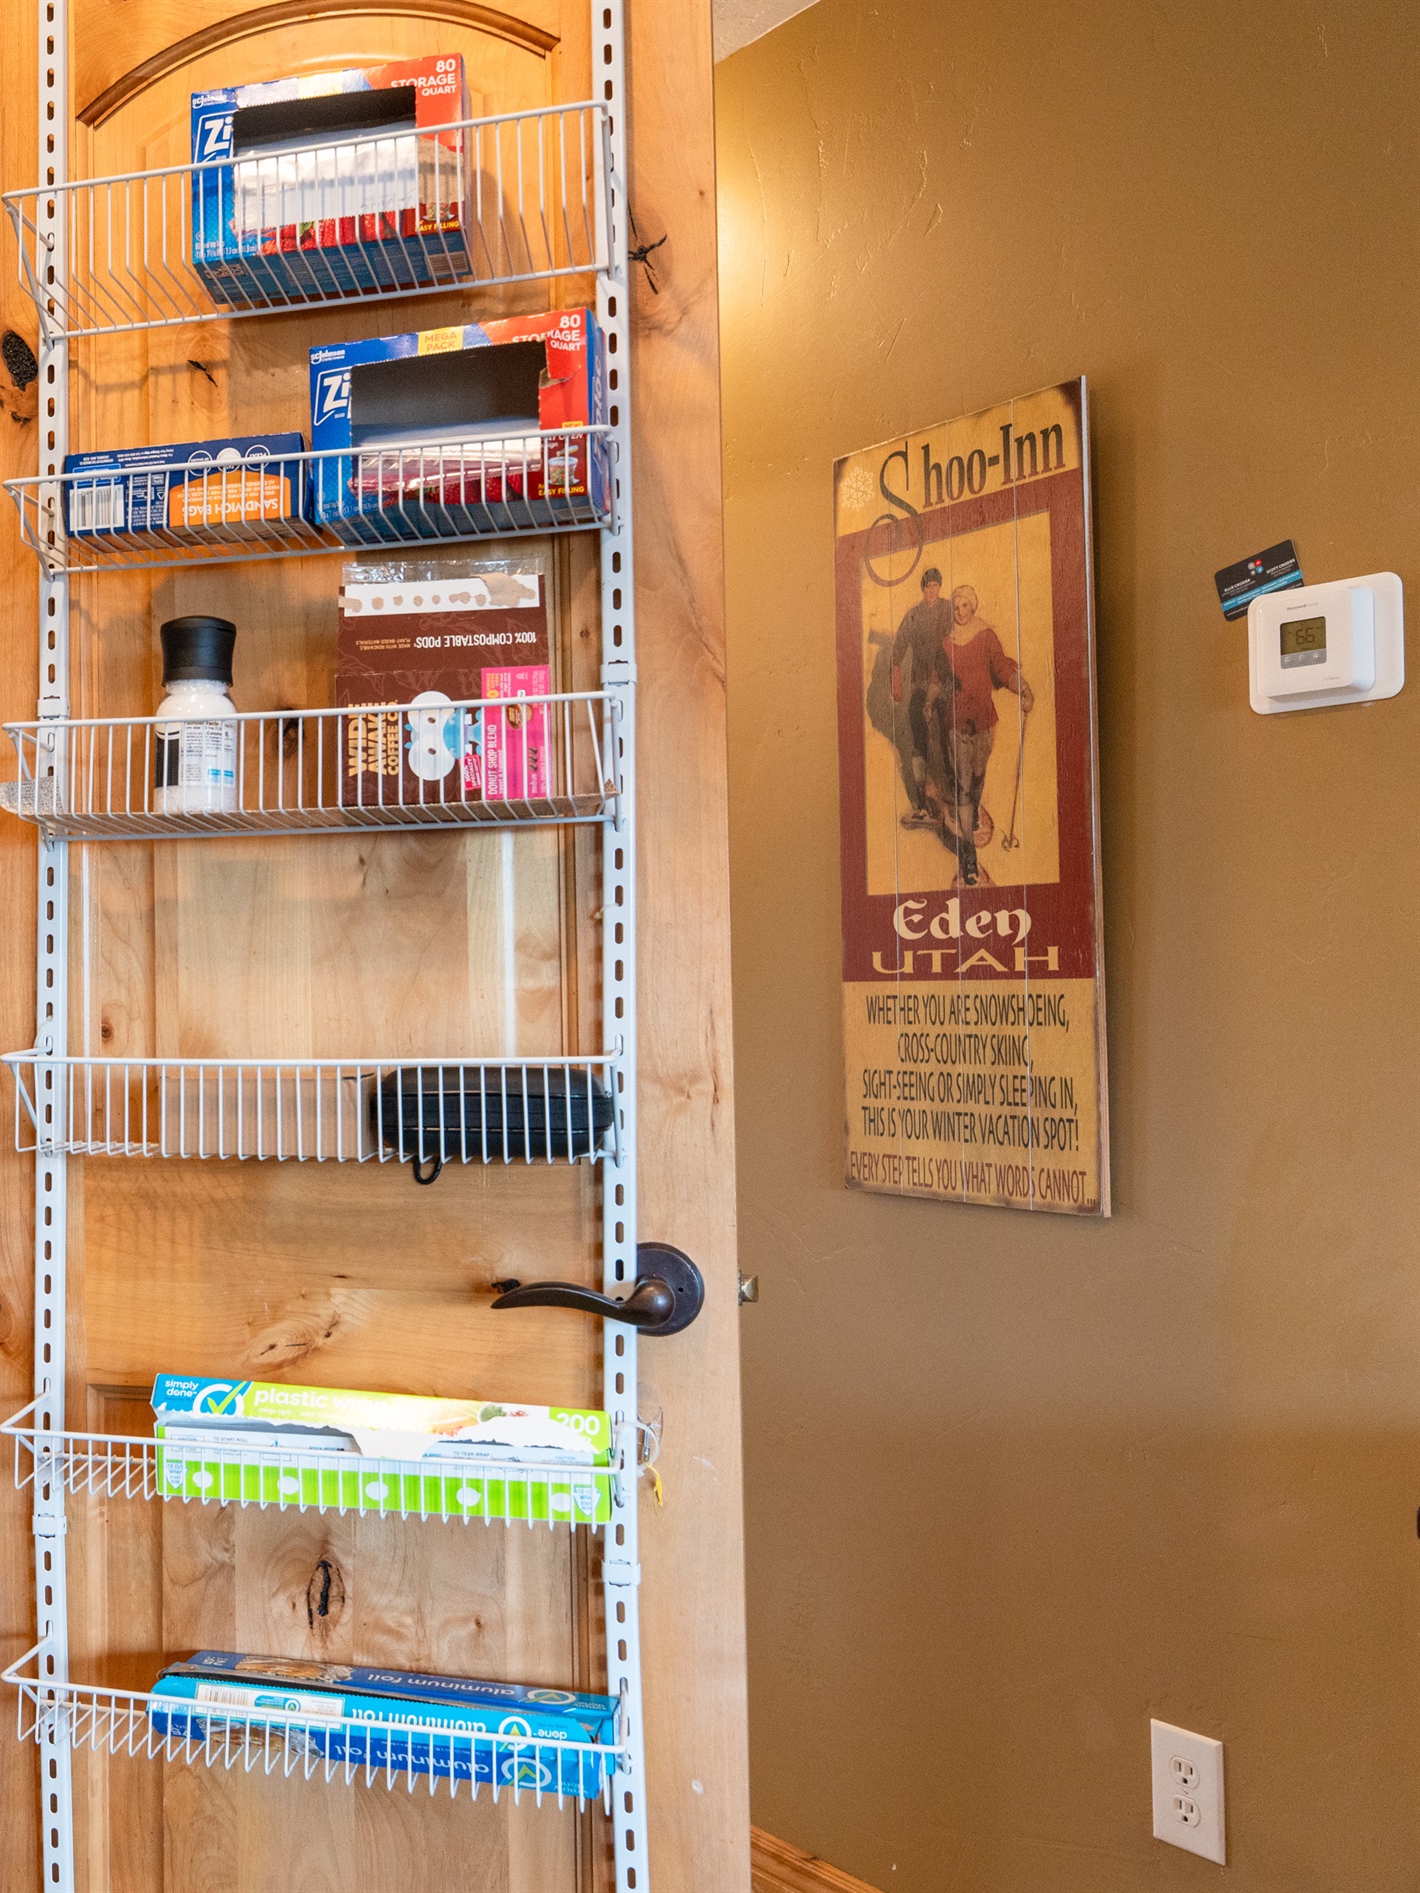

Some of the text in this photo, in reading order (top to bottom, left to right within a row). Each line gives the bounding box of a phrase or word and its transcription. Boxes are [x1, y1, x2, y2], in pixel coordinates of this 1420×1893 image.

[436, 58, 456, 72] 80
[390, 74, 456, 88] STORAGE
[422, 85, 456, 96] QUART
[415, 223, 432, 232] ASY
[560, 314, 581, 328] 80
[424, 331, 458, 342] MEGA
[550, 340, 580, 351] QUART
[426, 341, 456, 351] PACK
[182, 504, 212, 516] BAGS
[865, 423, 1066, 588] Shoo-Inn
[444, 632, 512, 648] COMPOSTABLE
[514, 632, 537, 644] 100%
[1296, 627, 1316, 645] 66
[386, 725, 398, 776] COFFEE
[487, 724, 498, 795] DONUT SHOP BLEND
[893, 898, 1032, 946] Eden
[872, 946, 1060, 974] UTAH
[866, 994, 1070, 1033] WHETHER YOU ARE SNOWSHOEING,
[898, 1033, 1034, 1072] CROSS-COUNTRY SKIING,
[862, 1069, 1078, 1116] SIGHT-SEEING OR SIMPLY SLEEPING IN,
[862, 1106, 1078, 1152] THIS IS YOUR WINTER VACATION SPOT!
[850, 1151, 1096, 1205] EVERY STEP TELLS YOU WHAT WORDS CANNOT...
[165, 1379, 198, 1391] simply
[166, 1388, 192, 1398] done
[254, 1388, 328, 1409] plastic
[557, 1412, 600, 1436] 200
[367, 1673, 515, 1696] aluminum foil
[537, 1728, 568, 1740] done
[376, 1750, 490, 1774] aluminum
